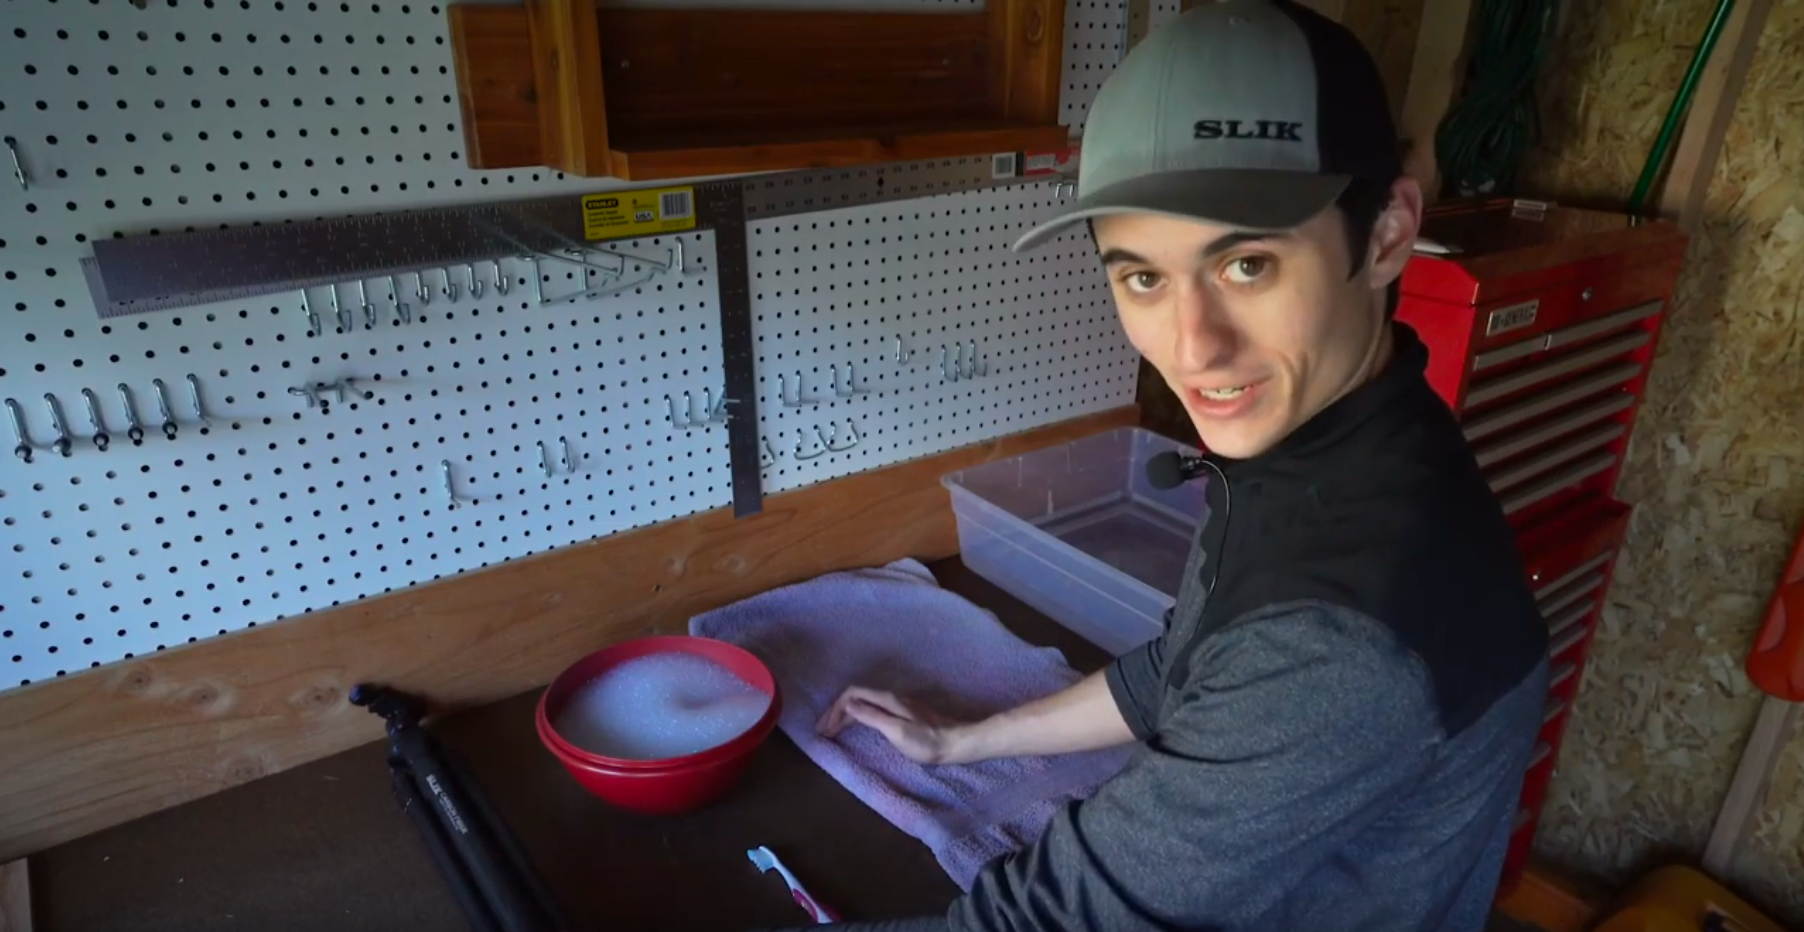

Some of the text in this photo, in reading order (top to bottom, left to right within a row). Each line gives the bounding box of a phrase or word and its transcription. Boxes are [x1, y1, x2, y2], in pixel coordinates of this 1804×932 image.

[1194, 119, 1302, 141] SLIK
[587, 199, 617, 209] STANLEY
[635, 212, 652, 220] USA
[426, 774, 442, 795] SLIK
